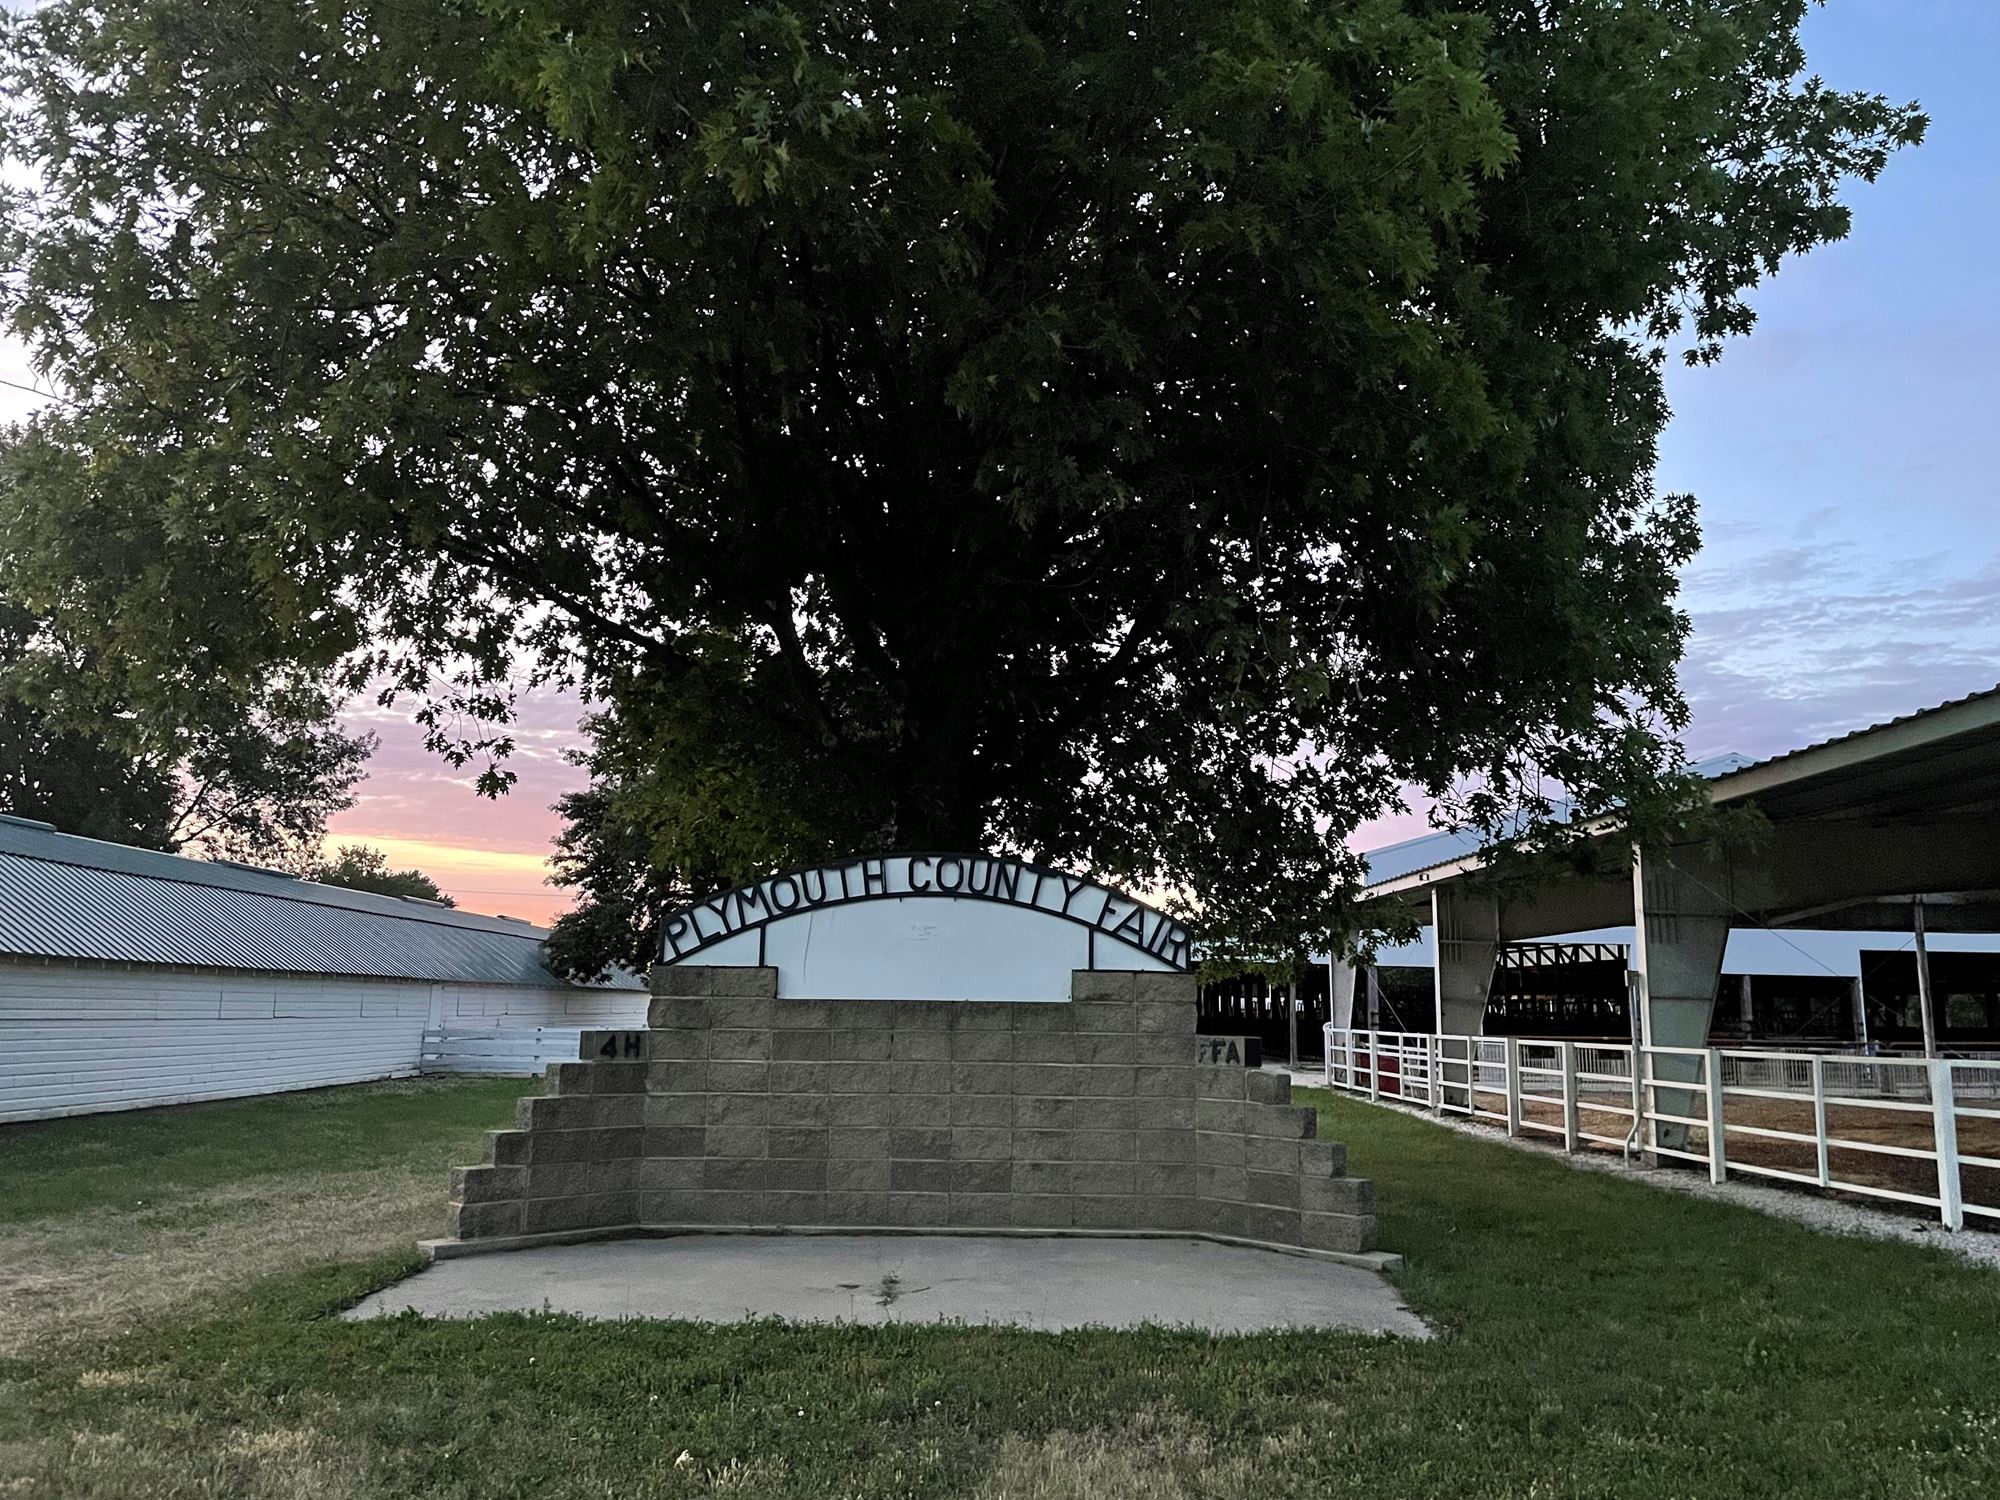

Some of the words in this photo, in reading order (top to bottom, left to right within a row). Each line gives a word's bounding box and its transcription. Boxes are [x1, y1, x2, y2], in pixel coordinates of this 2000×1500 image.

[665, 859, 887, 957] PLYMOUTH
[908, 856, 1087, 914] COUNTY
[1096, 892, 1188, 965] FAIR
[601, 1033, 640, 1058] 4H
